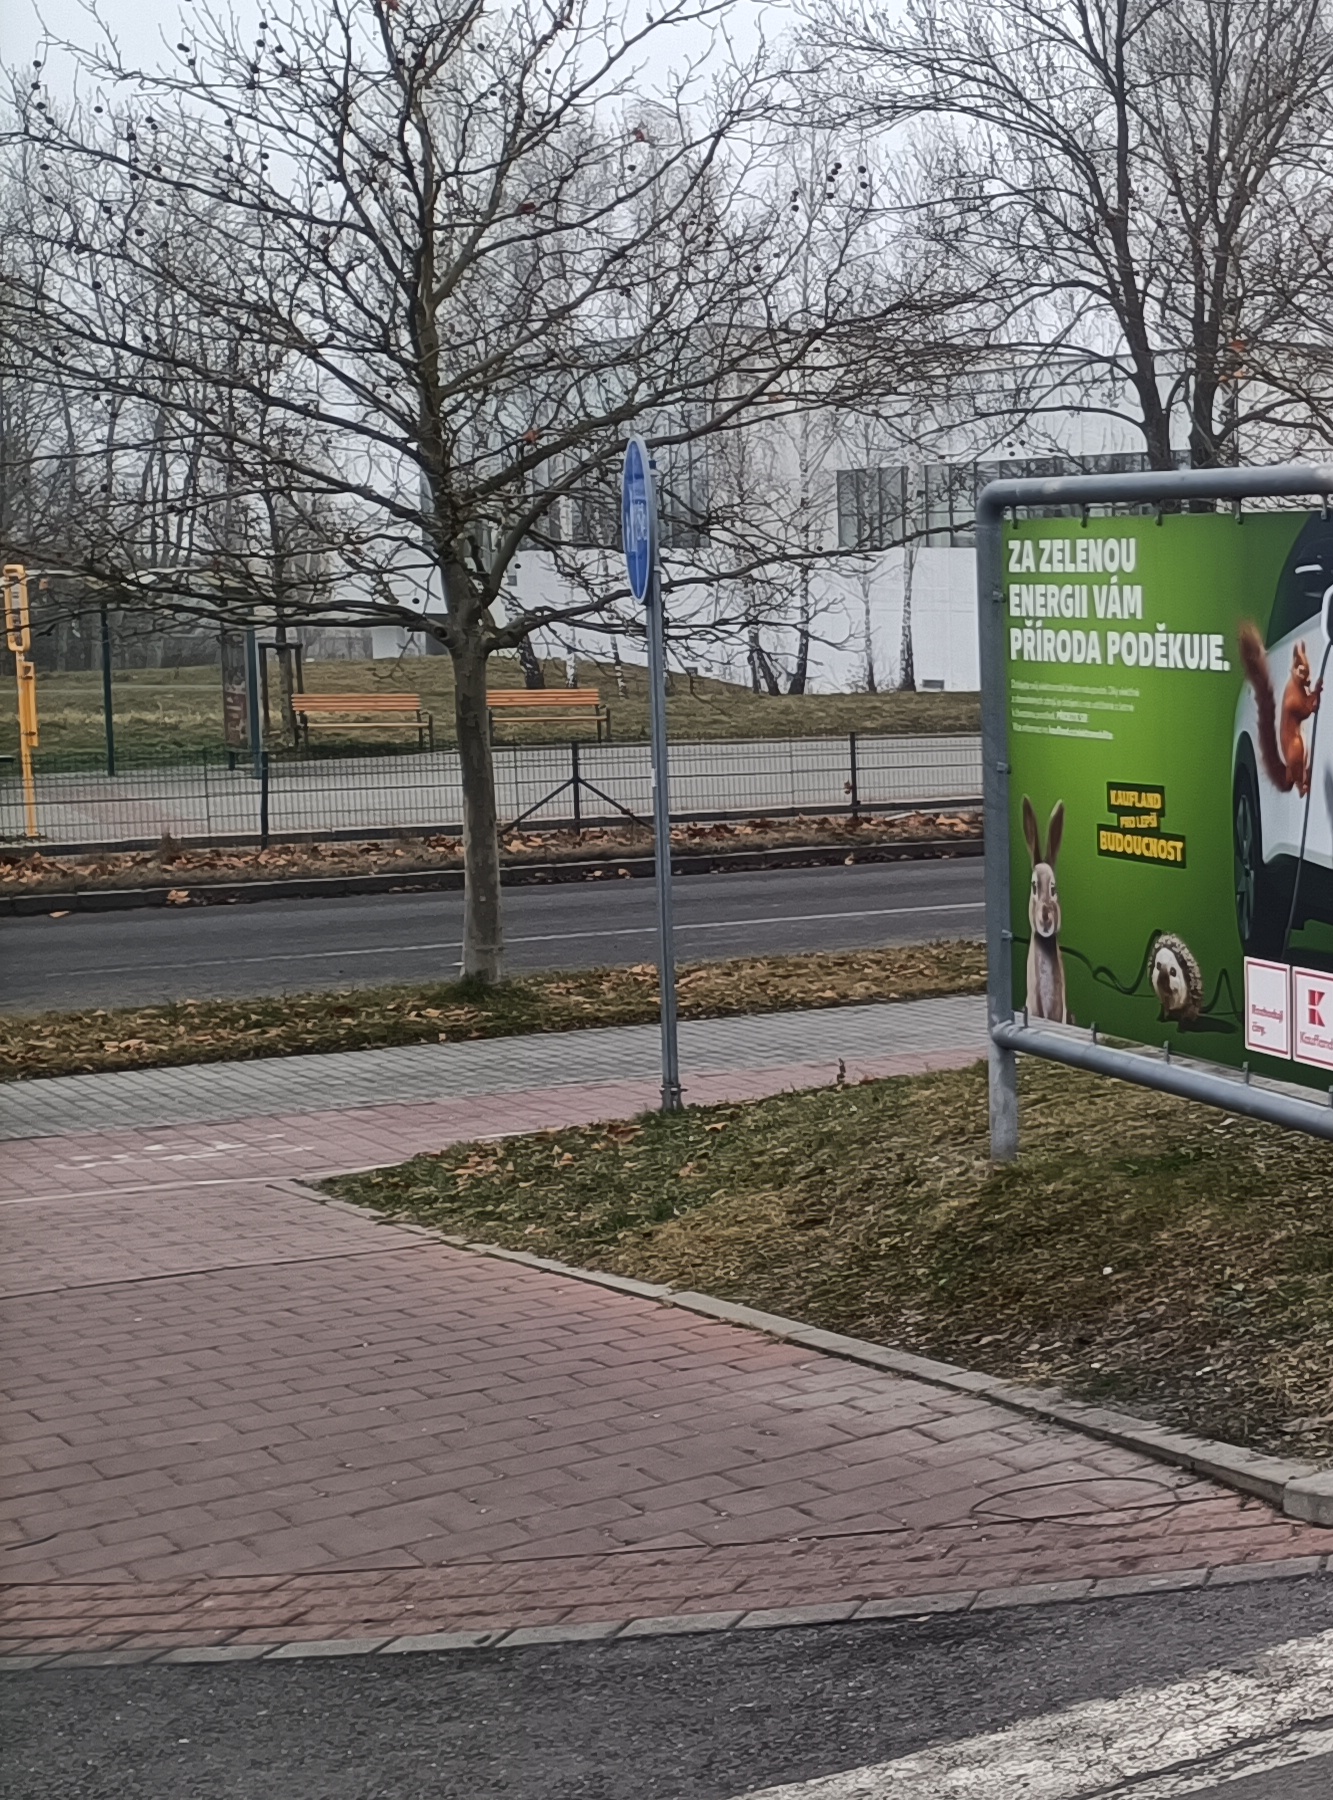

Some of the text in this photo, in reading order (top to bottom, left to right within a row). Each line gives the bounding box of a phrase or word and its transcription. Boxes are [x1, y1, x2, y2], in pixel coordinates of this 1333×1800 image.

[1008, 538, 1137, 573] ZA ZELENOU
[1009, 574, 1143, 620] ENERGII VÁM
[1009, 618, 1231, 672] PŘÍRODA PODĚKUJE.
[1110, 790, 1162, 809] KAUFLAND
[1099, 830, 1184, 862] BUDOUCNOST
